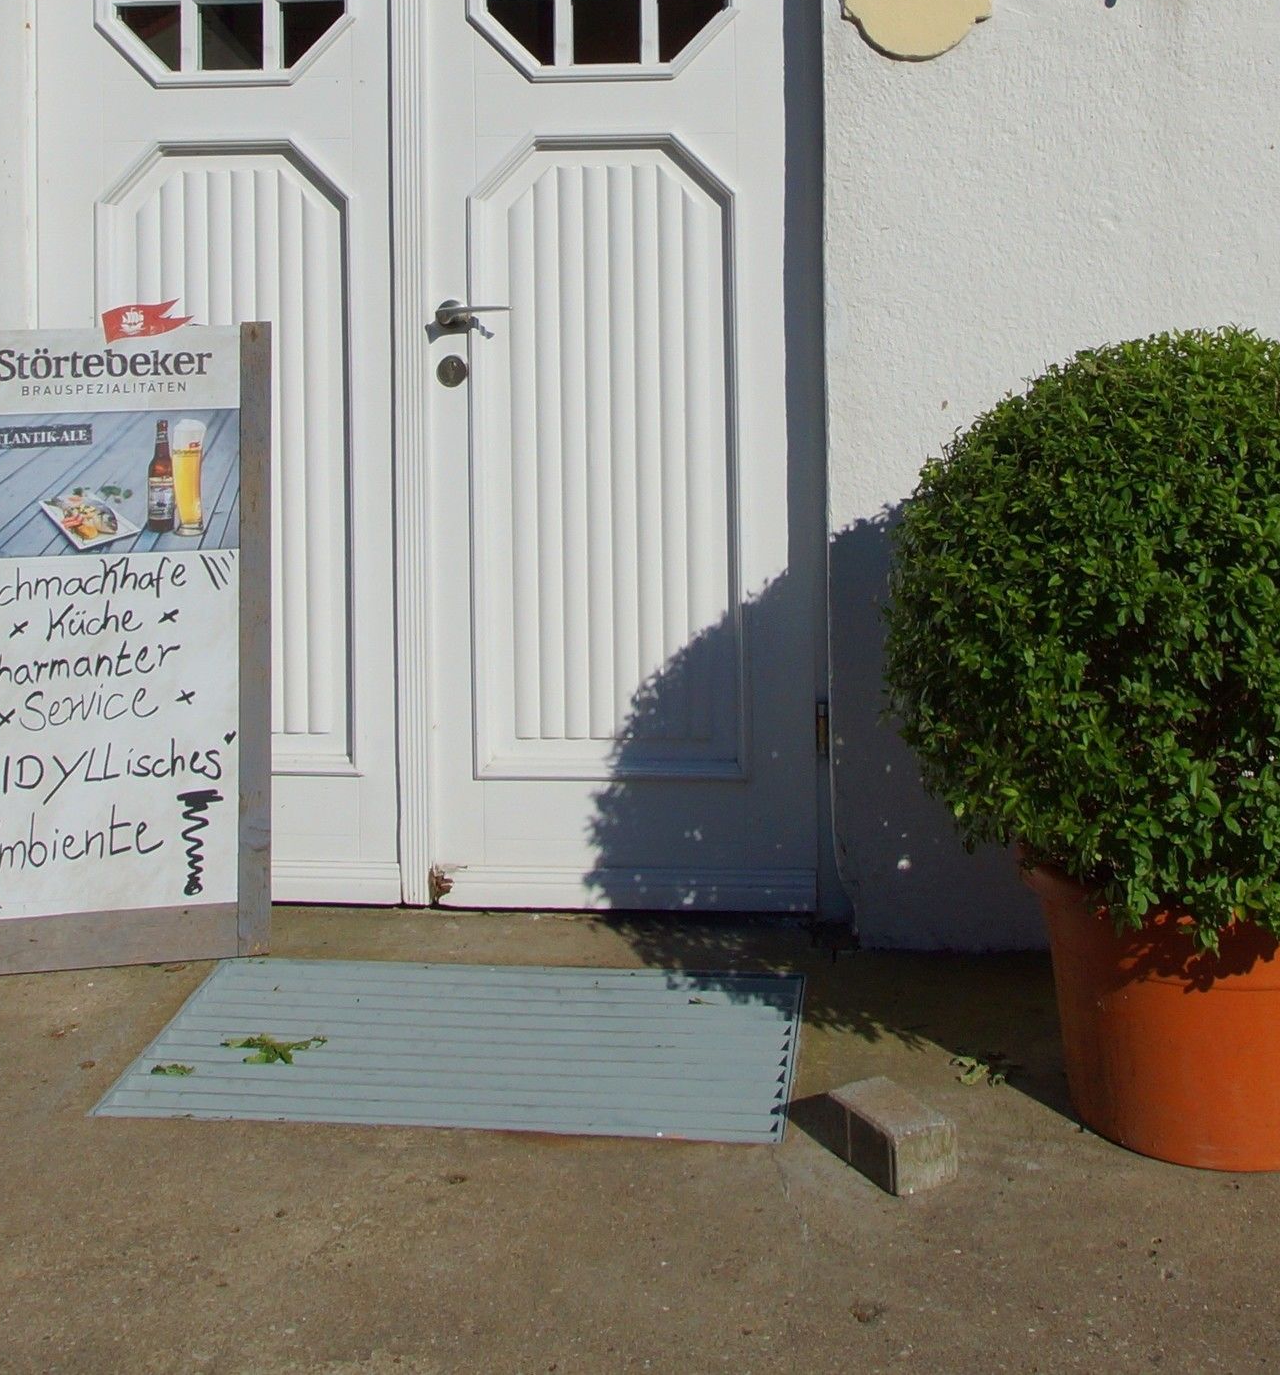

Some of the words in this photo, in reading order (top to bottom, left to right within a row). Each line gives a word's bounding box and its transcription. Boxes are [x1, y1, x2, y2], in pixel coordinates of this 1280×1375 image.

[21, 381, 187, 396] BRAUSPEZIALITÄTEN
[46, 600, 142, 642] Küche
[19, 683, 159, 732] Service
